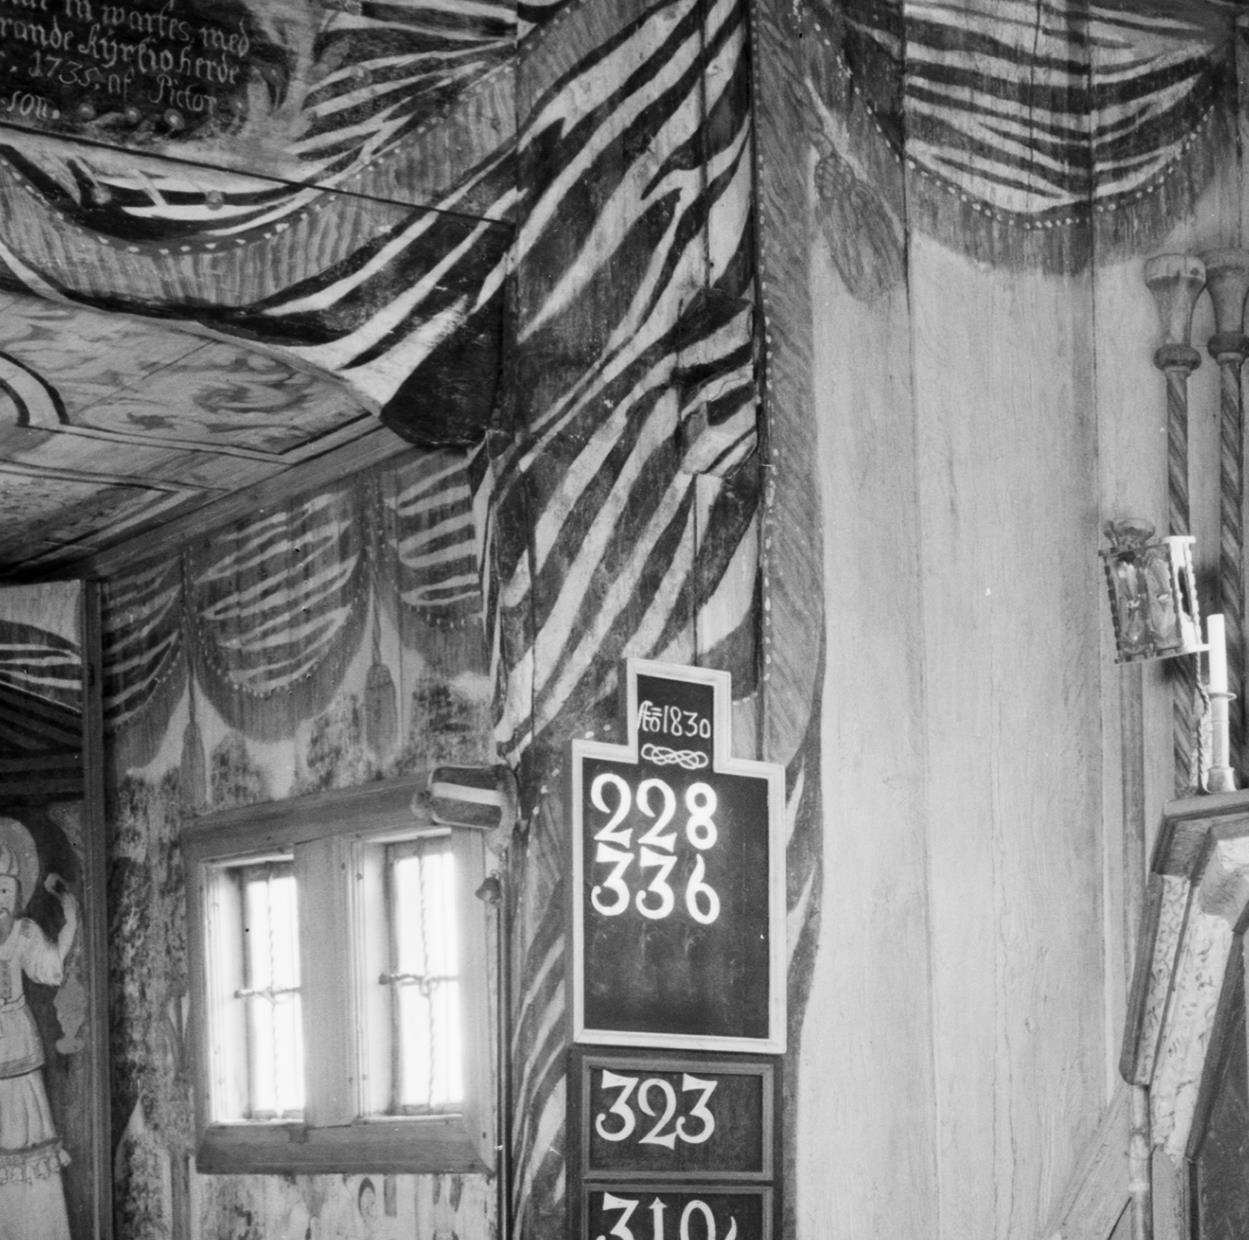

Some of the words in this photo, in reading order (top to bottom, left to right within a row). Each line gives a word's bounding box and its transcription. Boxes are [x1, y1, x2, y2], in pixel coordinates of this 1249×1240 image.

[200, 18, 250, 57] med
[663, 705, 712, 739] 1830
[590, 772, 718, 850] 228
[590, 844, 721, 924] 336
[595, 1068, 719, 1149] 323
